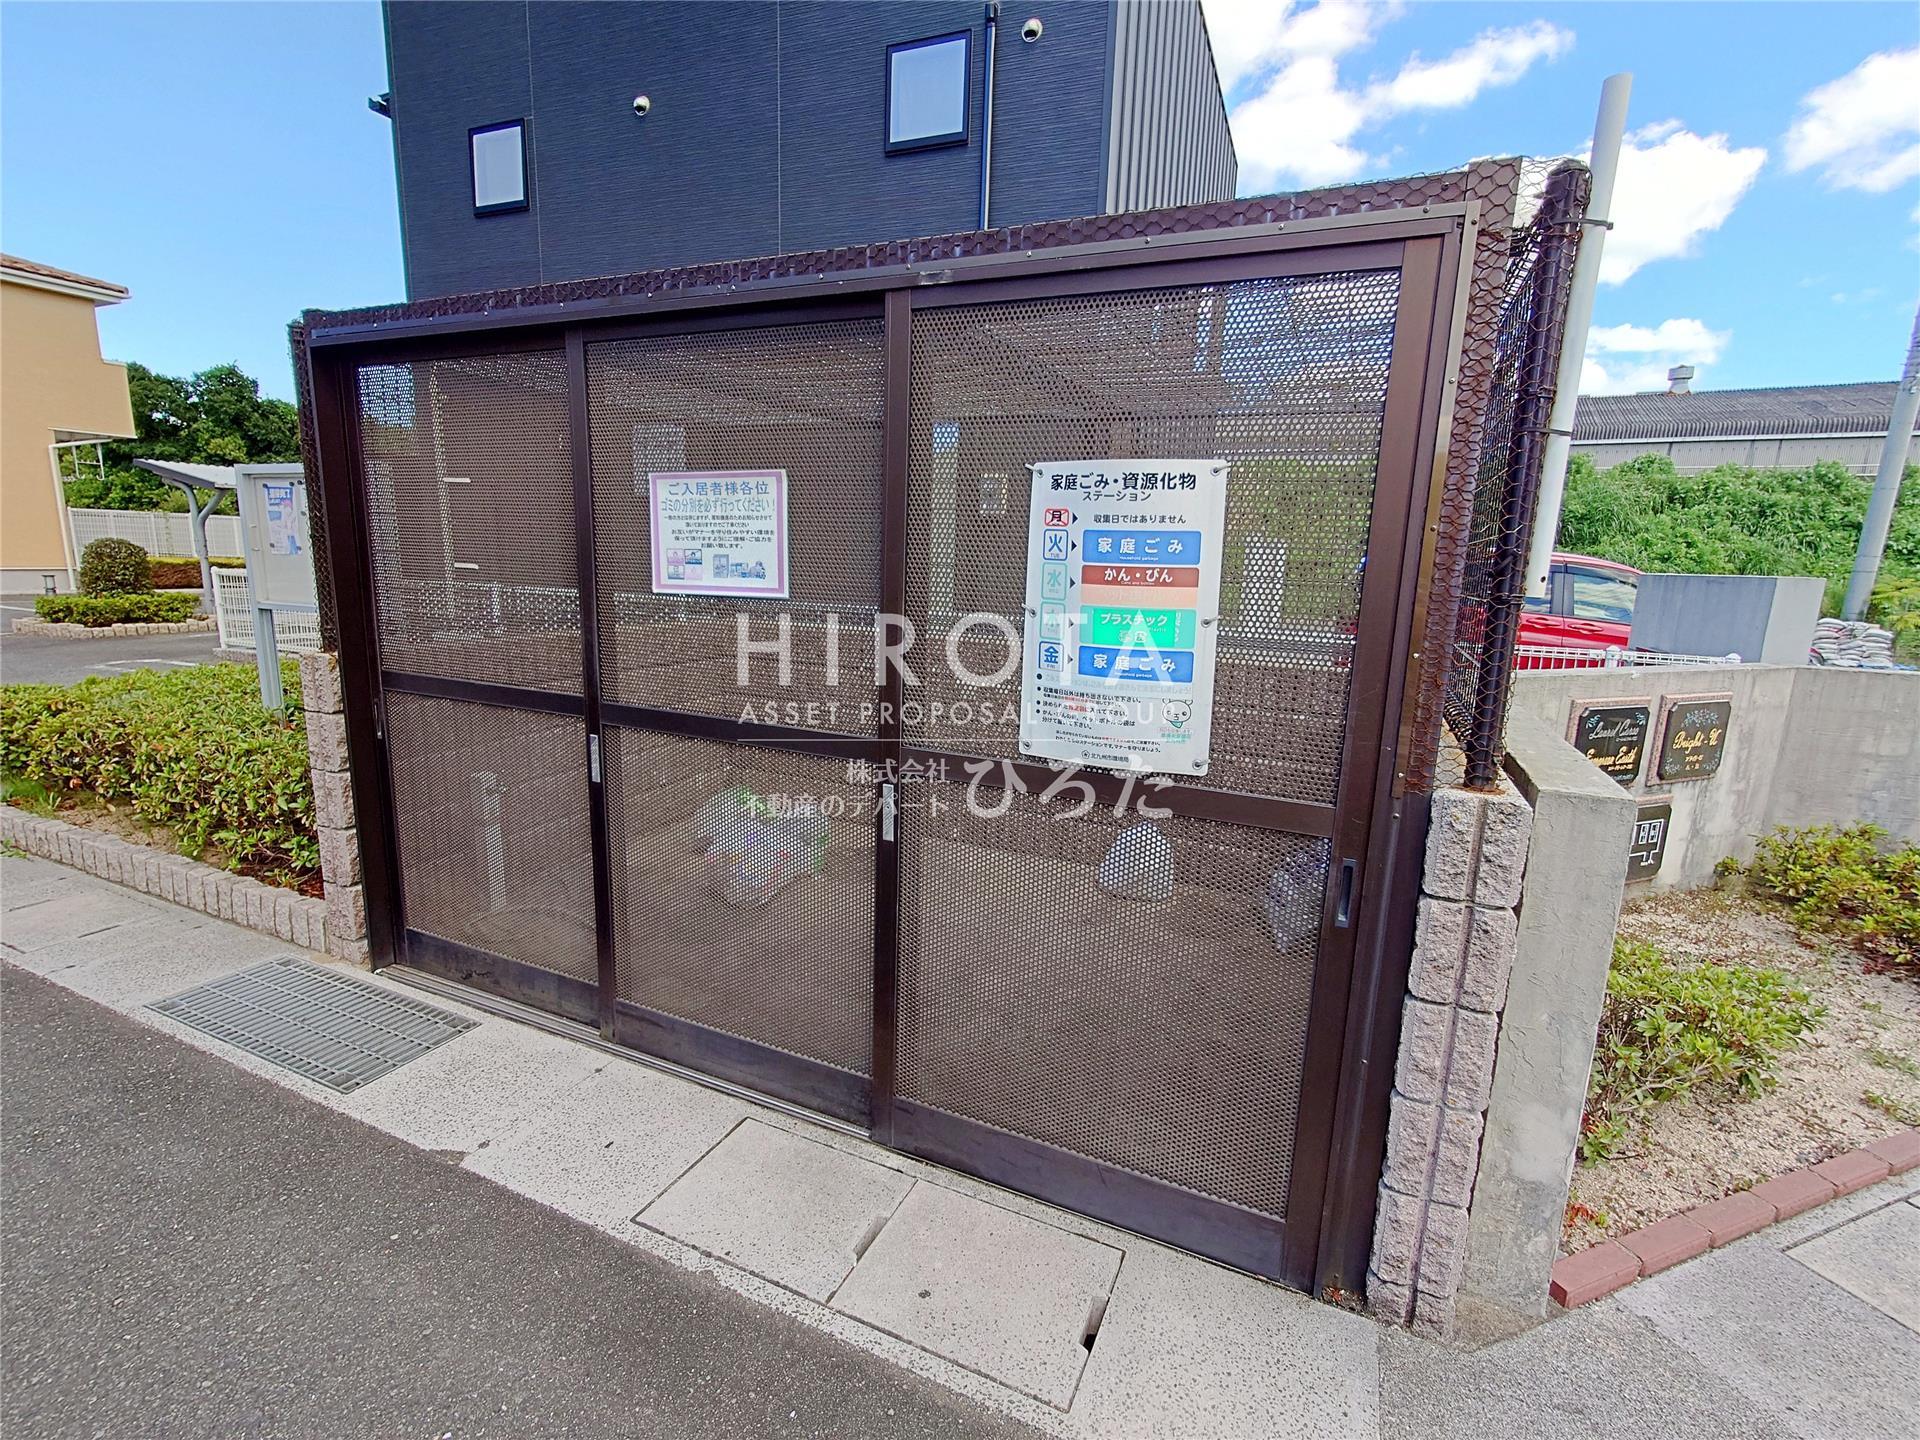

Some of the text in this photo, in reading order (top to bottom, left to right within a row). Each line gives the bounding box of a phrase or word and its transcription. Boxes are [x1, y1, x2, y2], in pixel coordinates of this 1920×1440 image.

[668, 480, 770, 496] ご入居者様各位
[1051, 472, 1196, 491] 家庭ごみ・資源化物
[1082, 491, 1151, 502] ステーション
[1093, 514, 1187, 524] 収集日ではありません
[1048, 533, 1062, 553] 火
[1097, 538, 1183, 554] 家庭ごみ
[1047, 569, 1061, 587] 水
[1104, 567, 1173, 583] かん・びん
[1101, 613, 1167, 627] プラスチック
[1043, 646, 1060, 665] 金
[1092, 653, 1176, 673] 家庭ごみ
